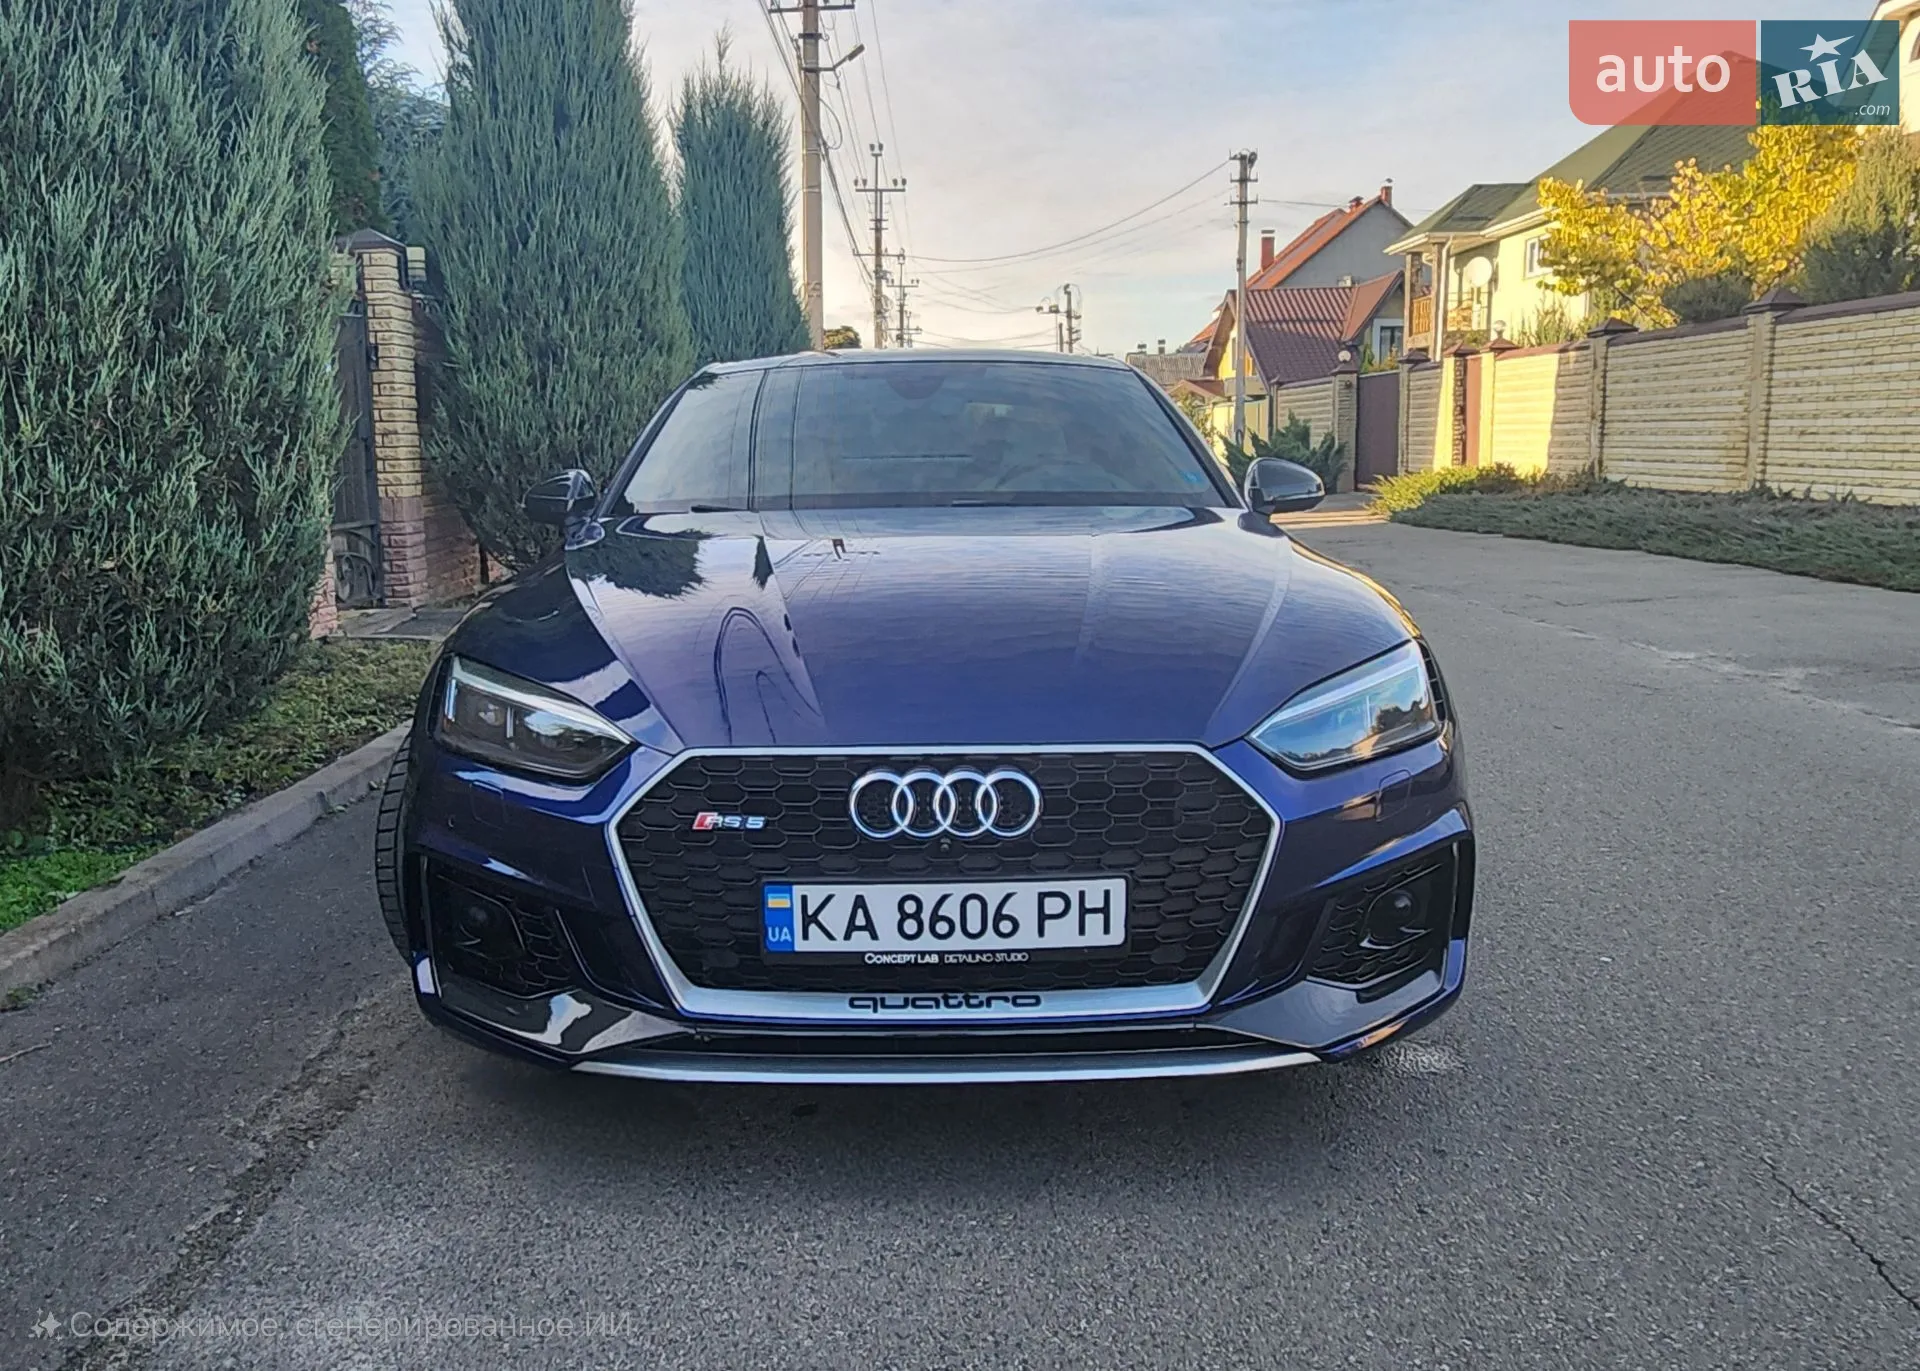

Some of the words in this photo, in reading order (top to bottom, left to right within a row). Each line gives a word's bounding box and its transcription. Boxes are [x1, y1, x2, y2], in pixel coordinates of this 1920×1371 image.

[801, 893, 880, 941] KA
[896, 892, 1020, 940] 8606
[1037, 889, 1111, 938] PH
[768, 926, 792, 942] UA
[917, 954, 939, 963] LAB
[995, 952, 1029, 963] STUDIO
[848, 993, 1042, 1013] quattro
